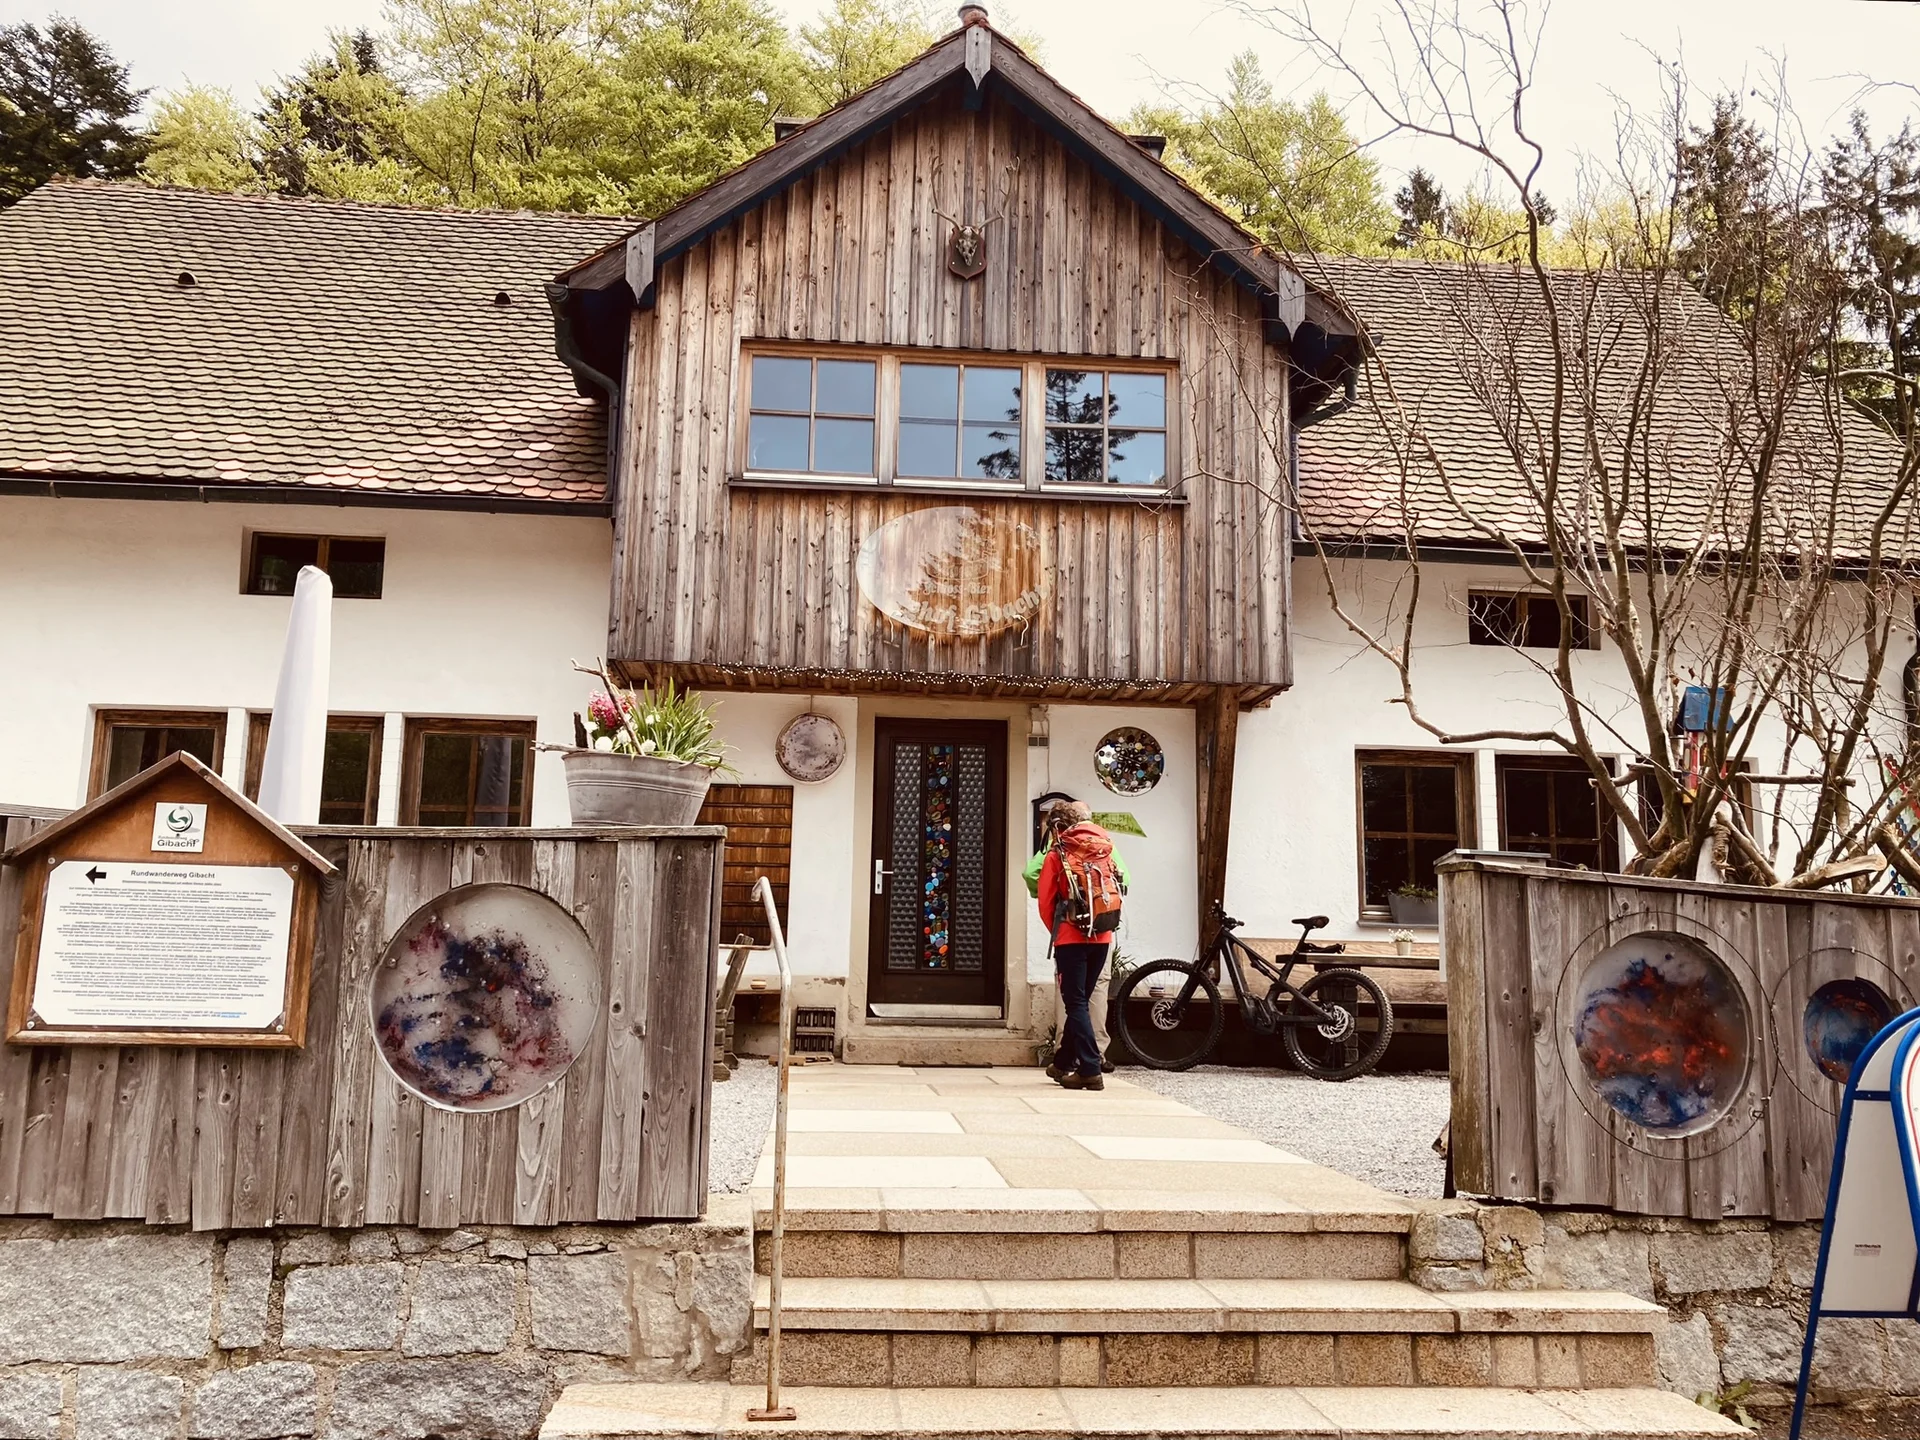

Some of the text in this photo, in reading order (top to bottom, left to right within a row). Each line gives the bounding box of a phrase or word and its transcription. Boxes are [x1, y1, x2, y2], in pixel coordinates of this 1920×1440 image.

[157, 838, 199, 848] Gibacht
[130, 869, 216, 880] Rundwanderweg Gibacht
